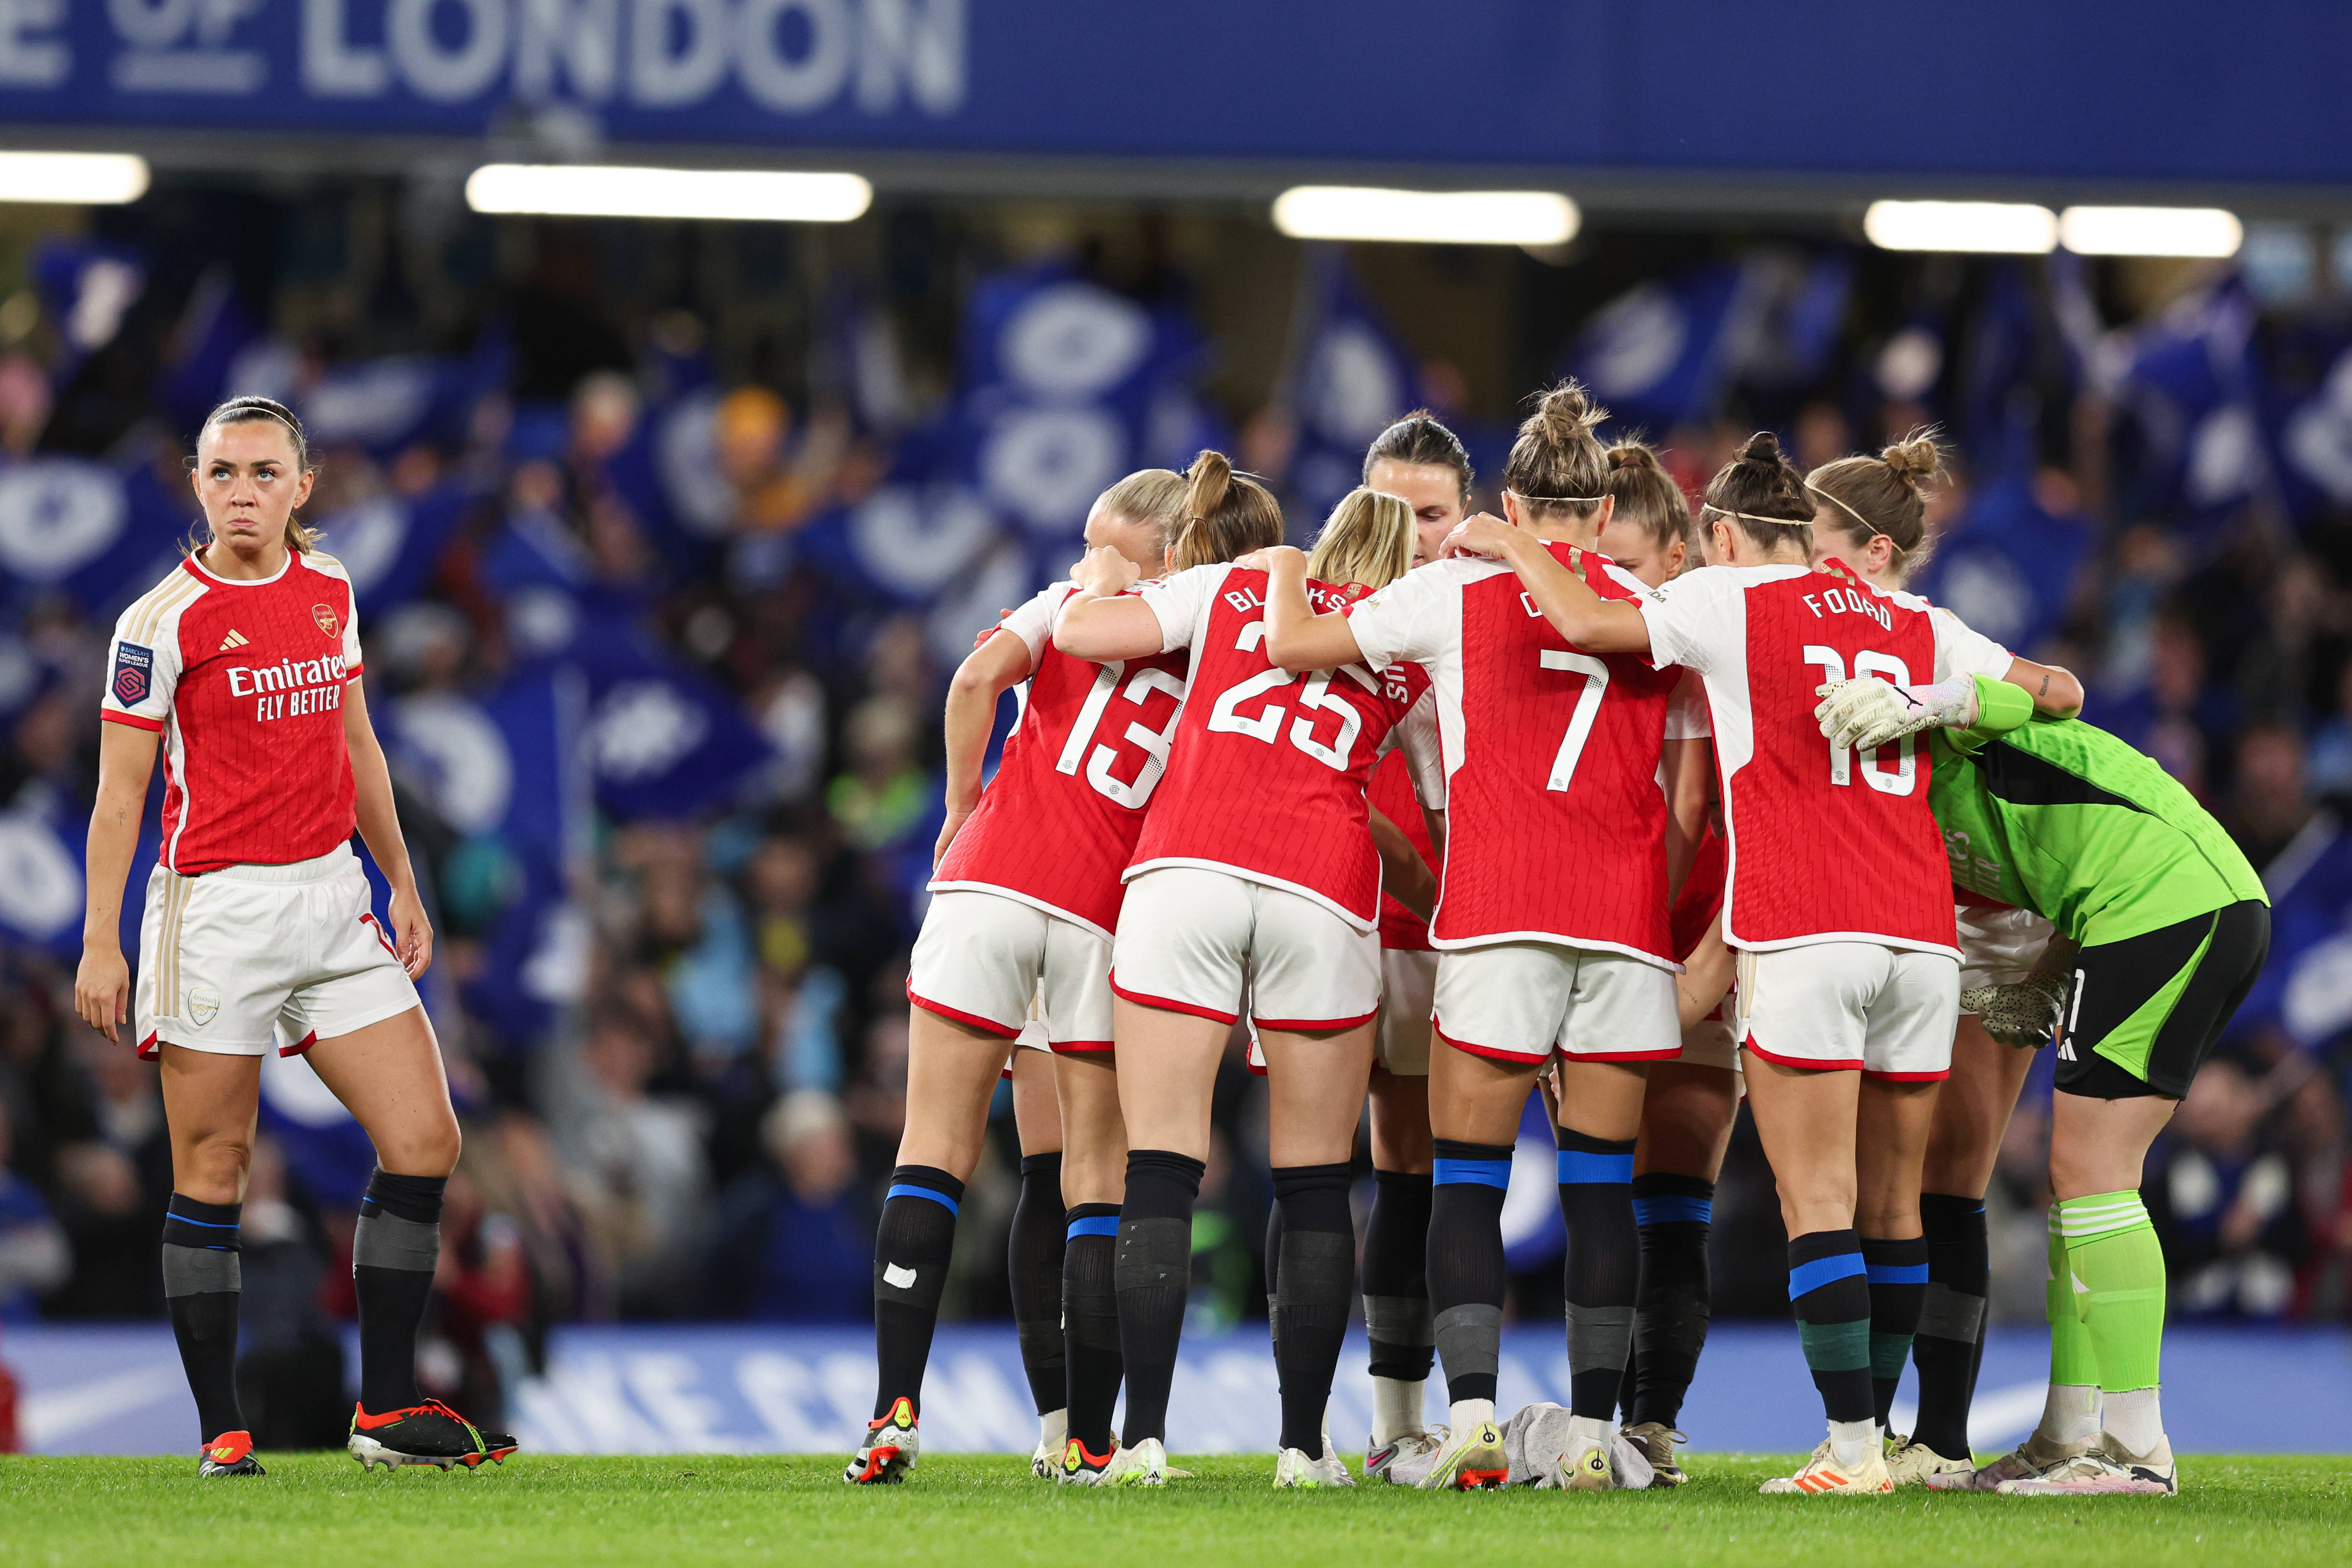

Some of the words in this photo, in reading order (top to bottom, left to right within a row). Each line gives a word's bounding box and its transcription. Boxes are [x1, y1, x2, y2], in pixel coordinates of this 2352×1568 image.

[300, 0, 965, 112] LONDON
[1802, 588, 1892, 632] FOORD
[119, 651, 149, 664] WOMEN'S
[125, 647, 150, 657] BARCLAYS
[225, 652, 347, 697] Emirates
[1207, 620, 1383, 772] 25
[257, 694, 284, 722] FLY
[290, 684, 340, 717] BETTER
[1540, 649, 1610, 792] 7
[1055, 660, 1185, 809] 13
[193, 994, 215, 1003] Arsenal
